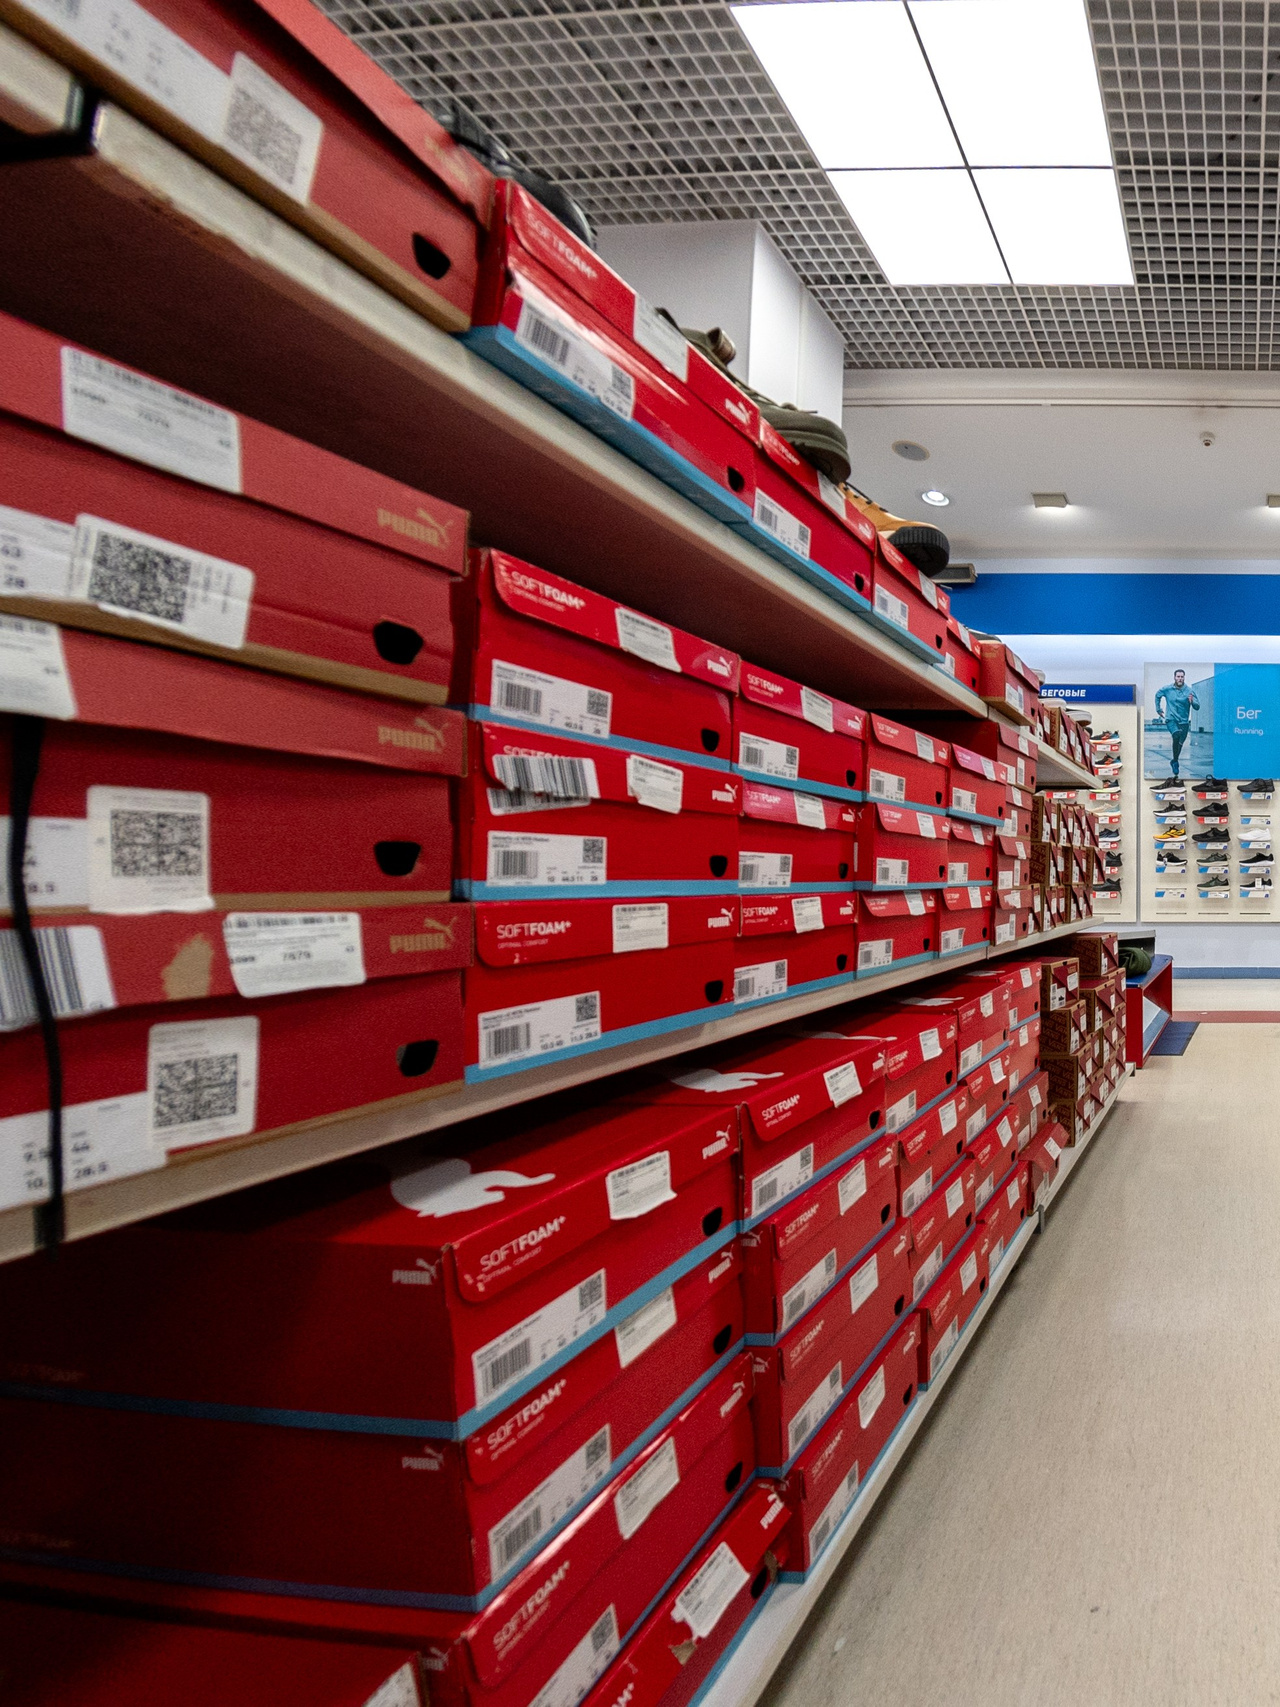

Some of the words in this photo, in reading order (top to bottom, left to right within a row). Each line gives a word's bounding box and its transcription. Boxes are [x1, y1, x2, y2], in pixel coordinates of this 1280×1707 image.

[376, 507, 439, 547] PUMA
[1041, 689, 1086, 697] БЕГОВЫЕ
[1236, 706, 1263, 720] Бег
[377, 726, 436, 752] PUMA
[1234, 727, 1264, 737] Running
[711, 789, 734, 804] PUMA
[707, 916, 731, 929] PUMA
[389, 932, 444, 953] PUMA
[702, 1138, 728, 1159] PUMA
[759, 1498, 784, 1529] PUMA
